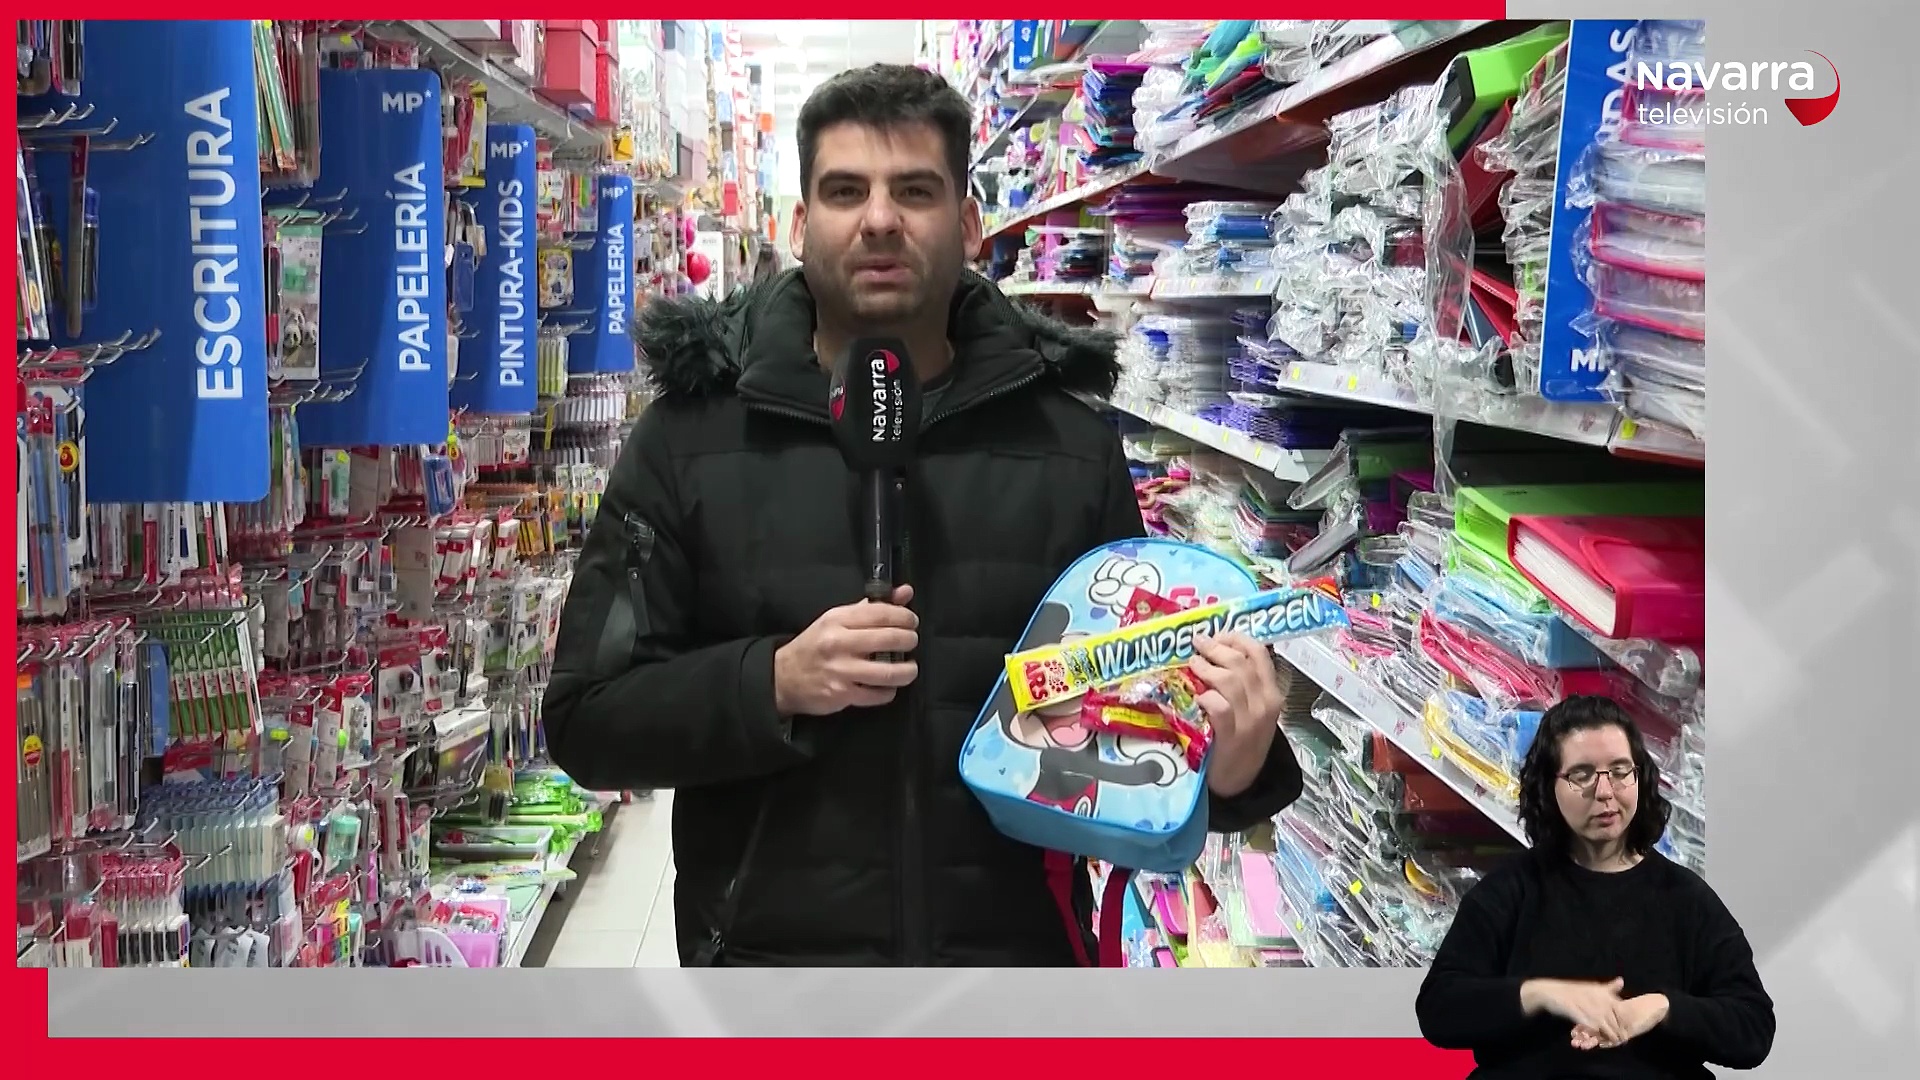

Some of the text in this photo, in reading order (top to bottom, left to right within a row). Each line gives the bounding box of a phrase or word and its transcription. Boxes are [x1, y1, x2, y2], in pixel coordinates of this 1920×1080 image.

[184, 87, 243, 399] ESCRITURA
[385, 162, 431, 372] PAPELERÍA
[498, 180, 525, 386] PINTURA-KIDS
[604, 223, 625, 335] PAPELERÍA
[871, 359, 887, 441] Navarra
